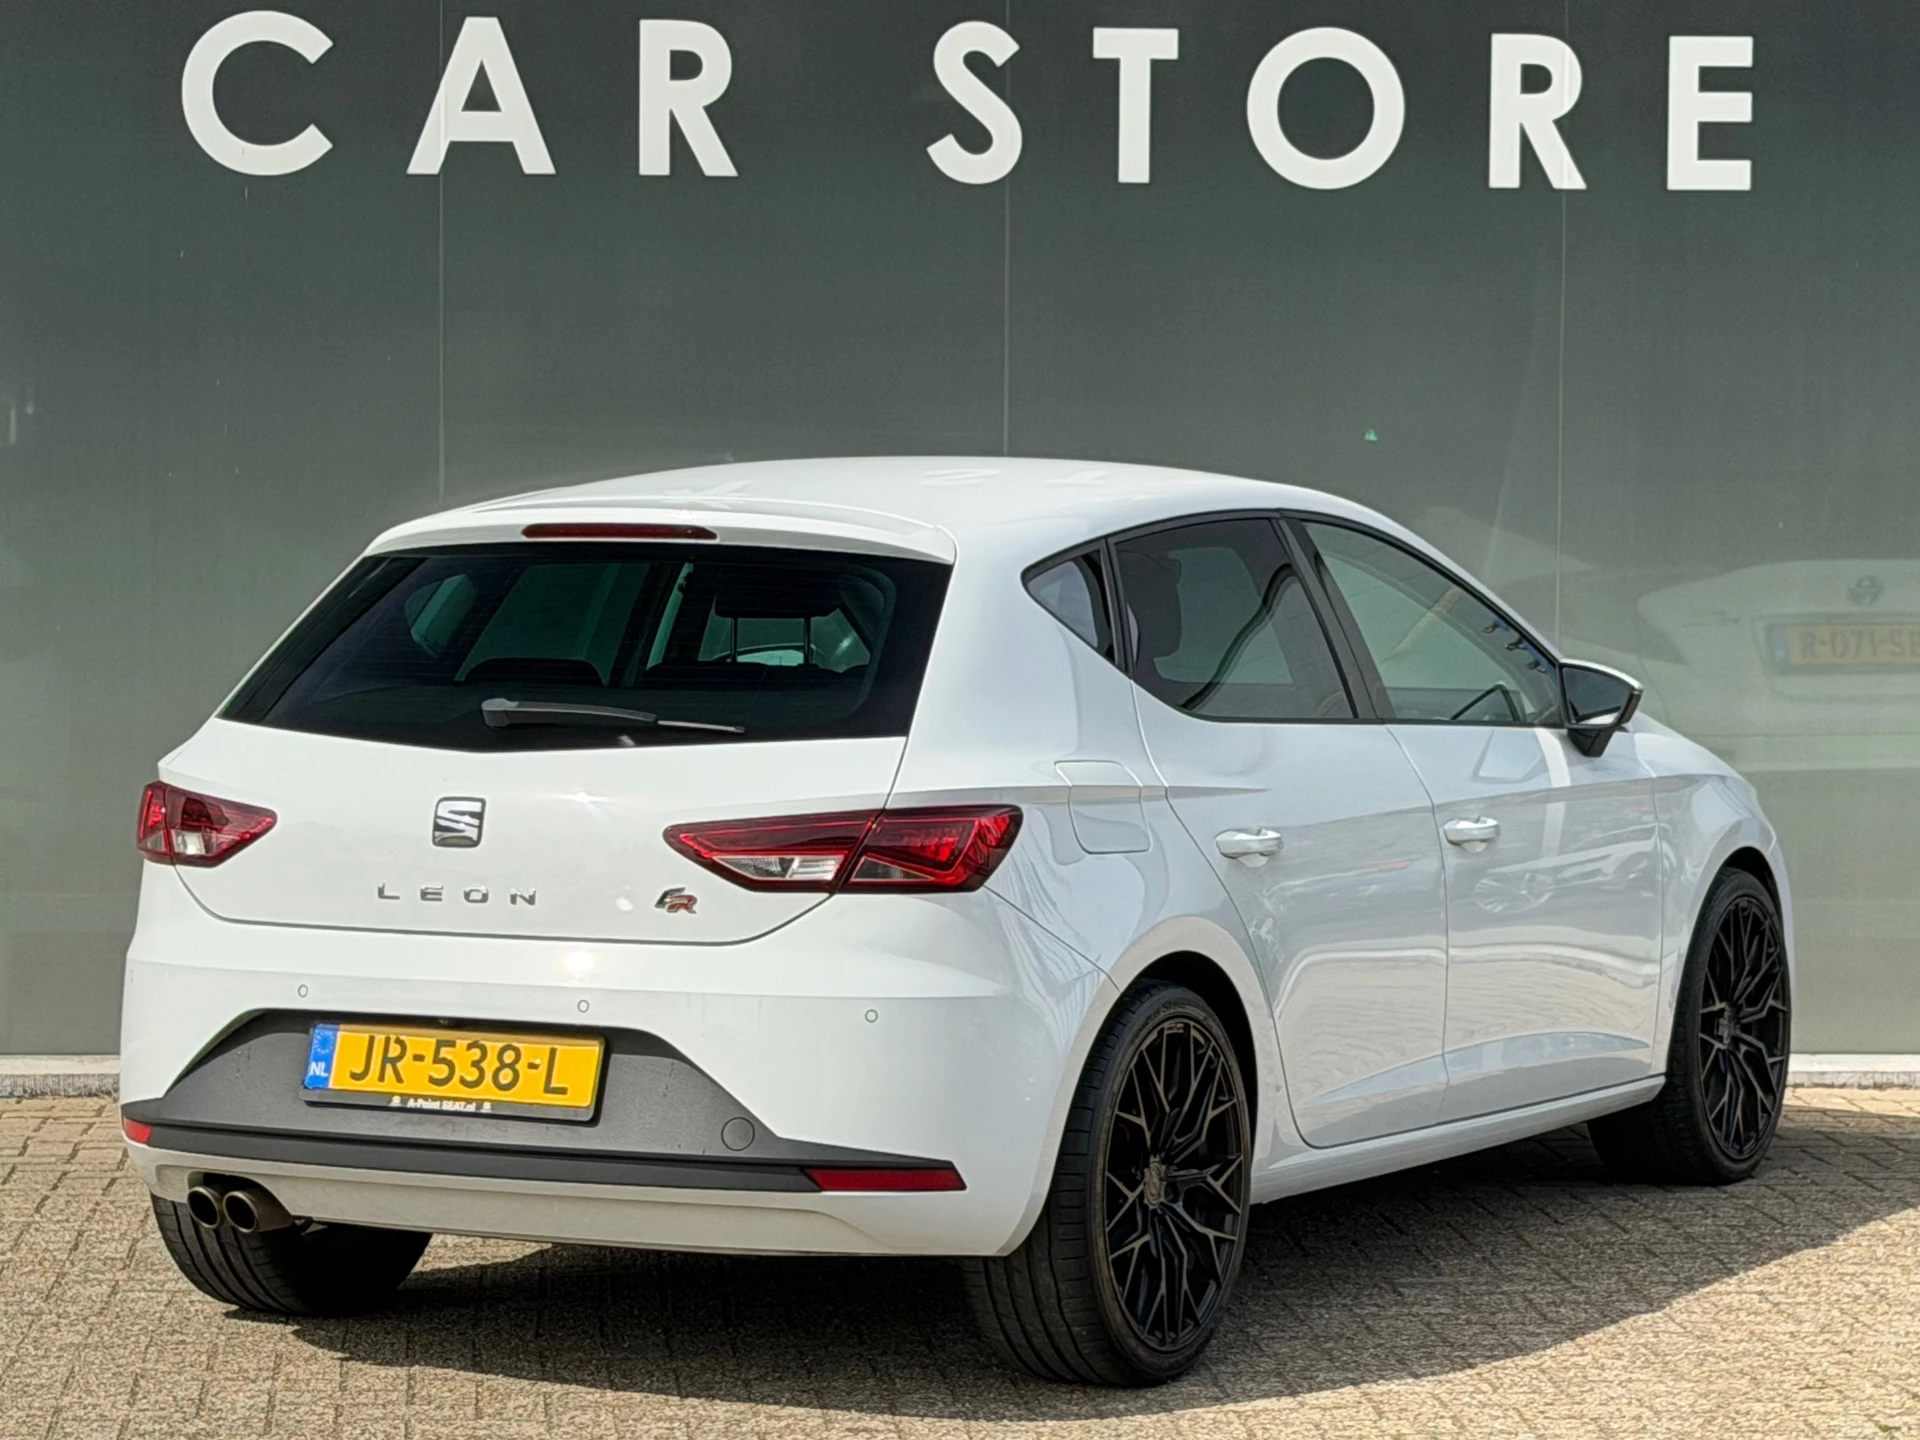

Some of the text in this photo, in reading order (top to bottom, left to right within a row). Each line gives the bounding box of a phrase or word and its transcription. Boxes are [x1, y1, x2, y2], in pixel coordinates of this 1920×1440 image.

[182, 10, 1754, 191] CAR STORE
[377, 882, 537, 906] LEON
[308, 1061, 329, 1077] NL
[349, 1034, 569, 1096] JR-538-L
